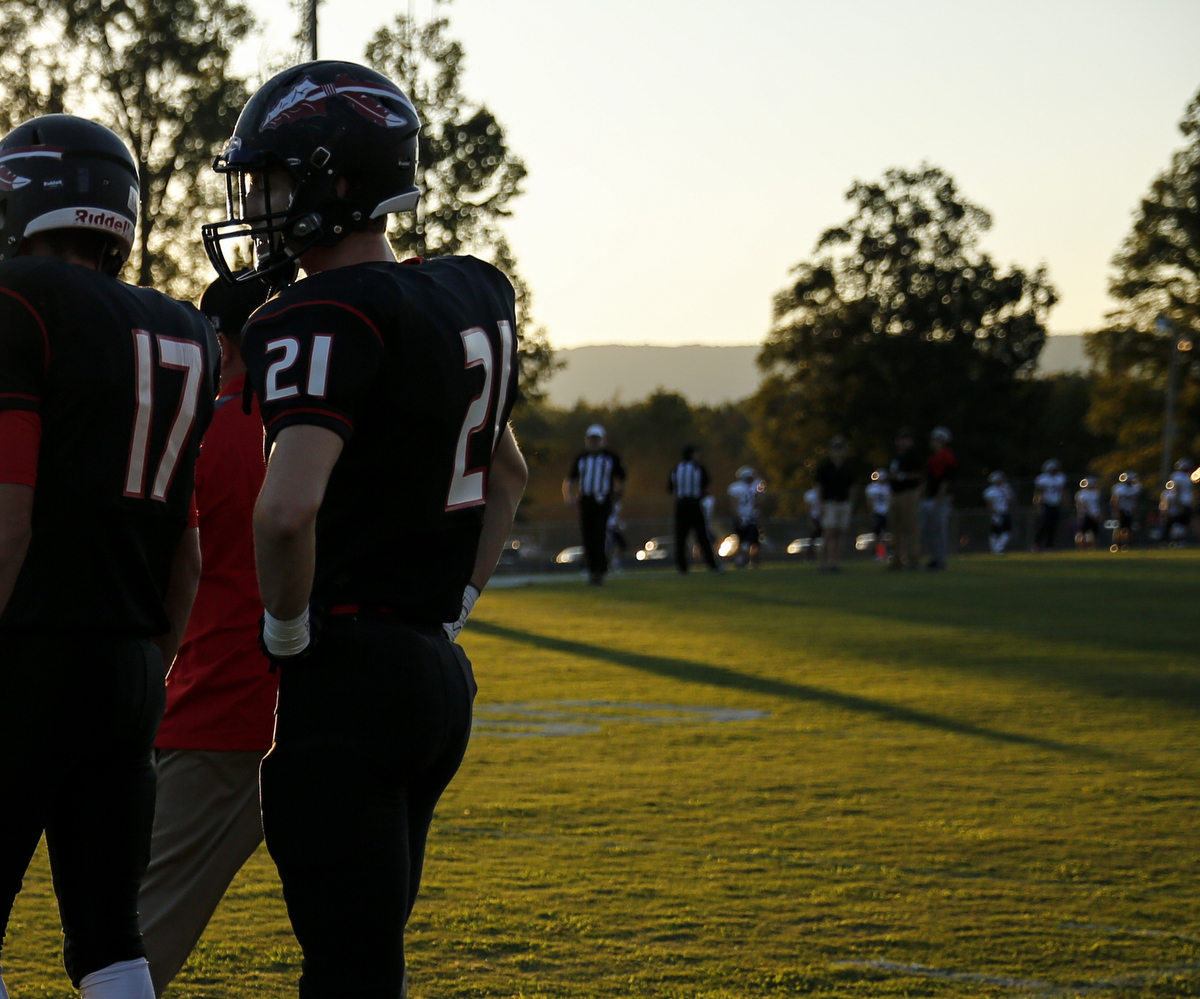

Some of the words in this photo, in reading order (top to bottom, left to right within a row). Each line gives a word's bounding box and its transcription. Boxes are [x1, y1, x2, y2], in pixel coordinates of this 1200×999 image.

[122, 328, 204, 503] 17
[264, 333, 335, 403] 21
[445, 319, 513, 512] 21
